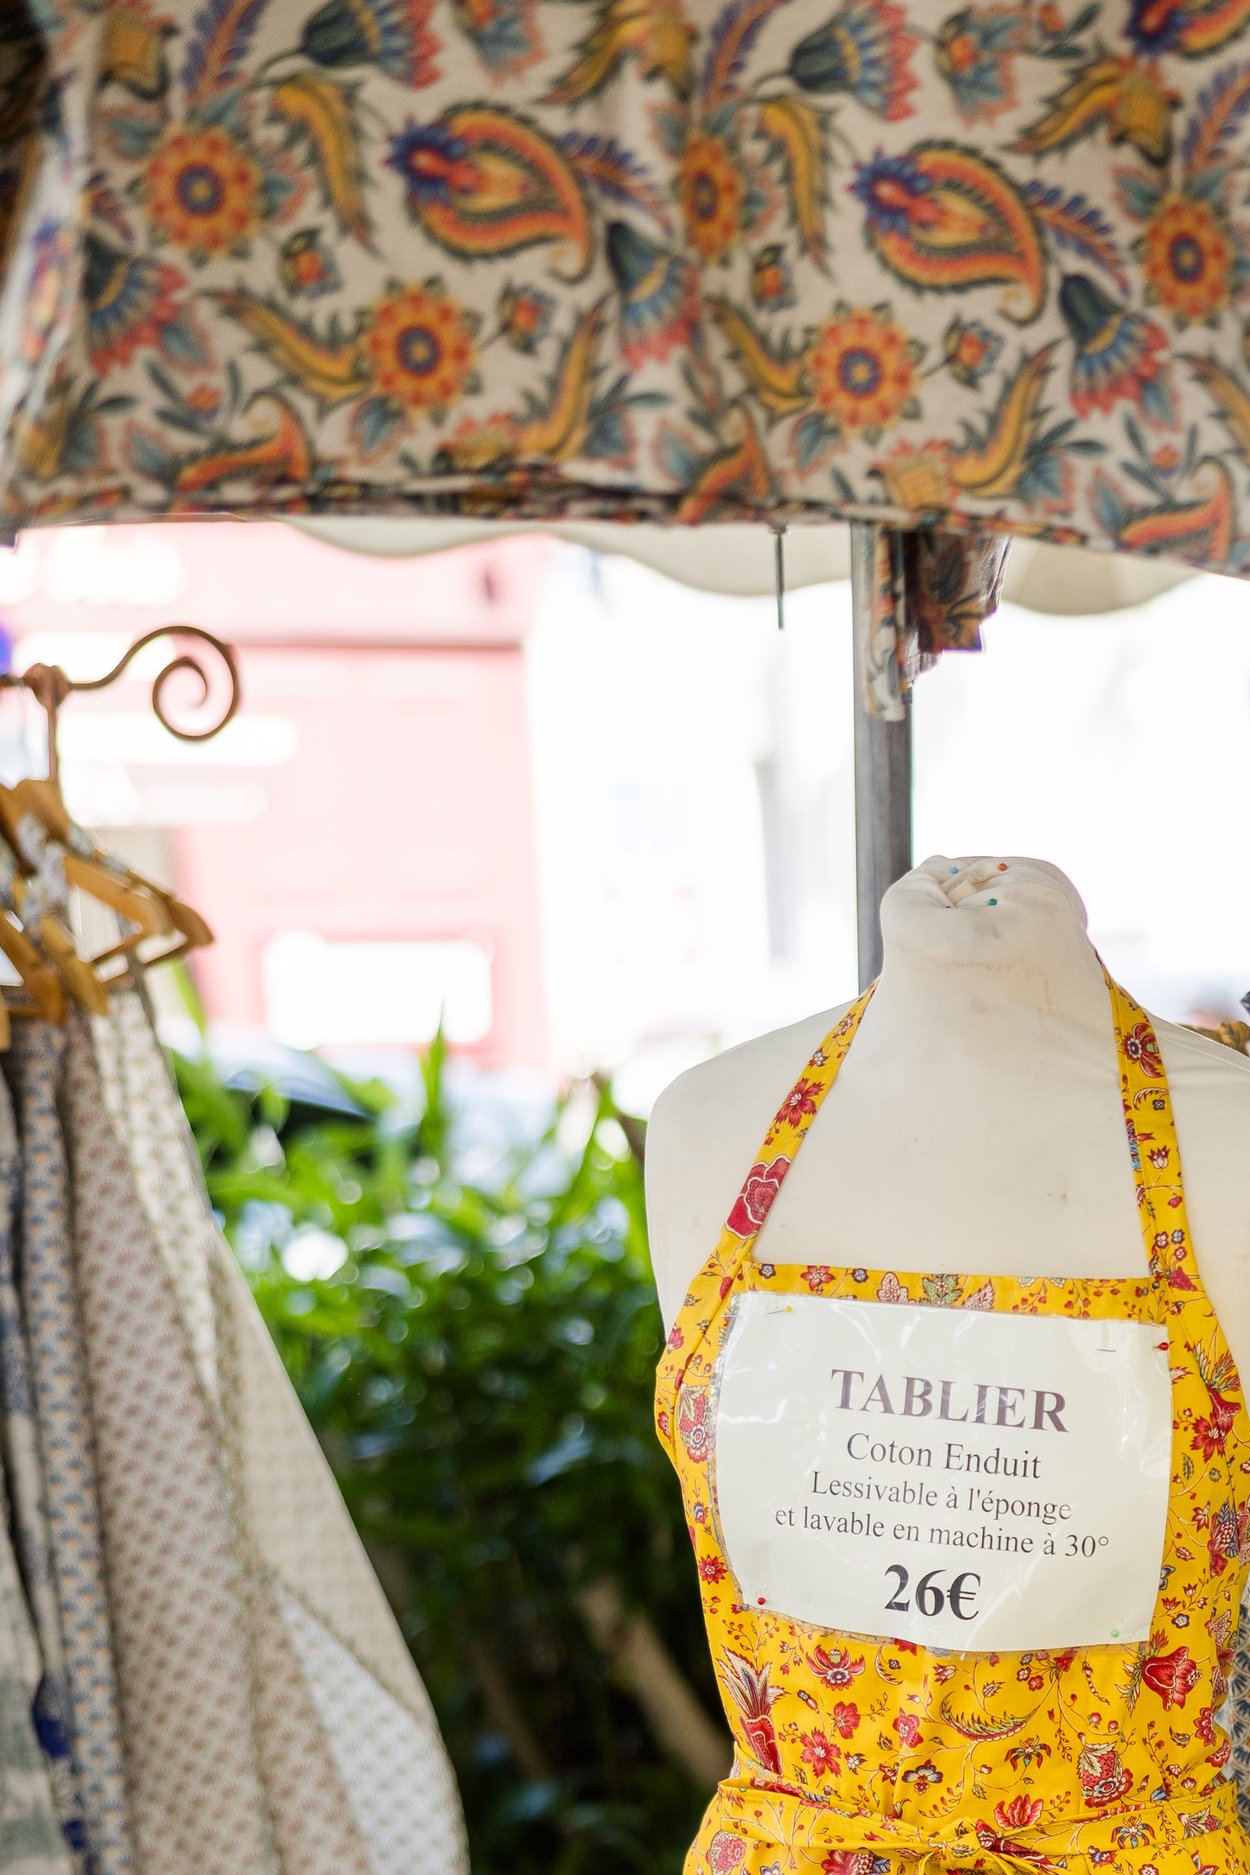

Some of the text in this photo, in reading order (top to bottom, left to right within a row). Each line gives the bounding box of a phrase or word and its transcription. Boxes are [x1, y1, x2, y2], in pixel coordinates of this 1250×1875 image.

[830, 1368, 1070, 1433] TABLIER
[846, 1432, 1042, 1479] Coton Enduit
[812, 1470, 1072, 1526] Lessivable à l'éponge
[775, 1505, 1109, 1558] et lavable en machine à 30°
[884, 1563, 982, 1621] 26€
